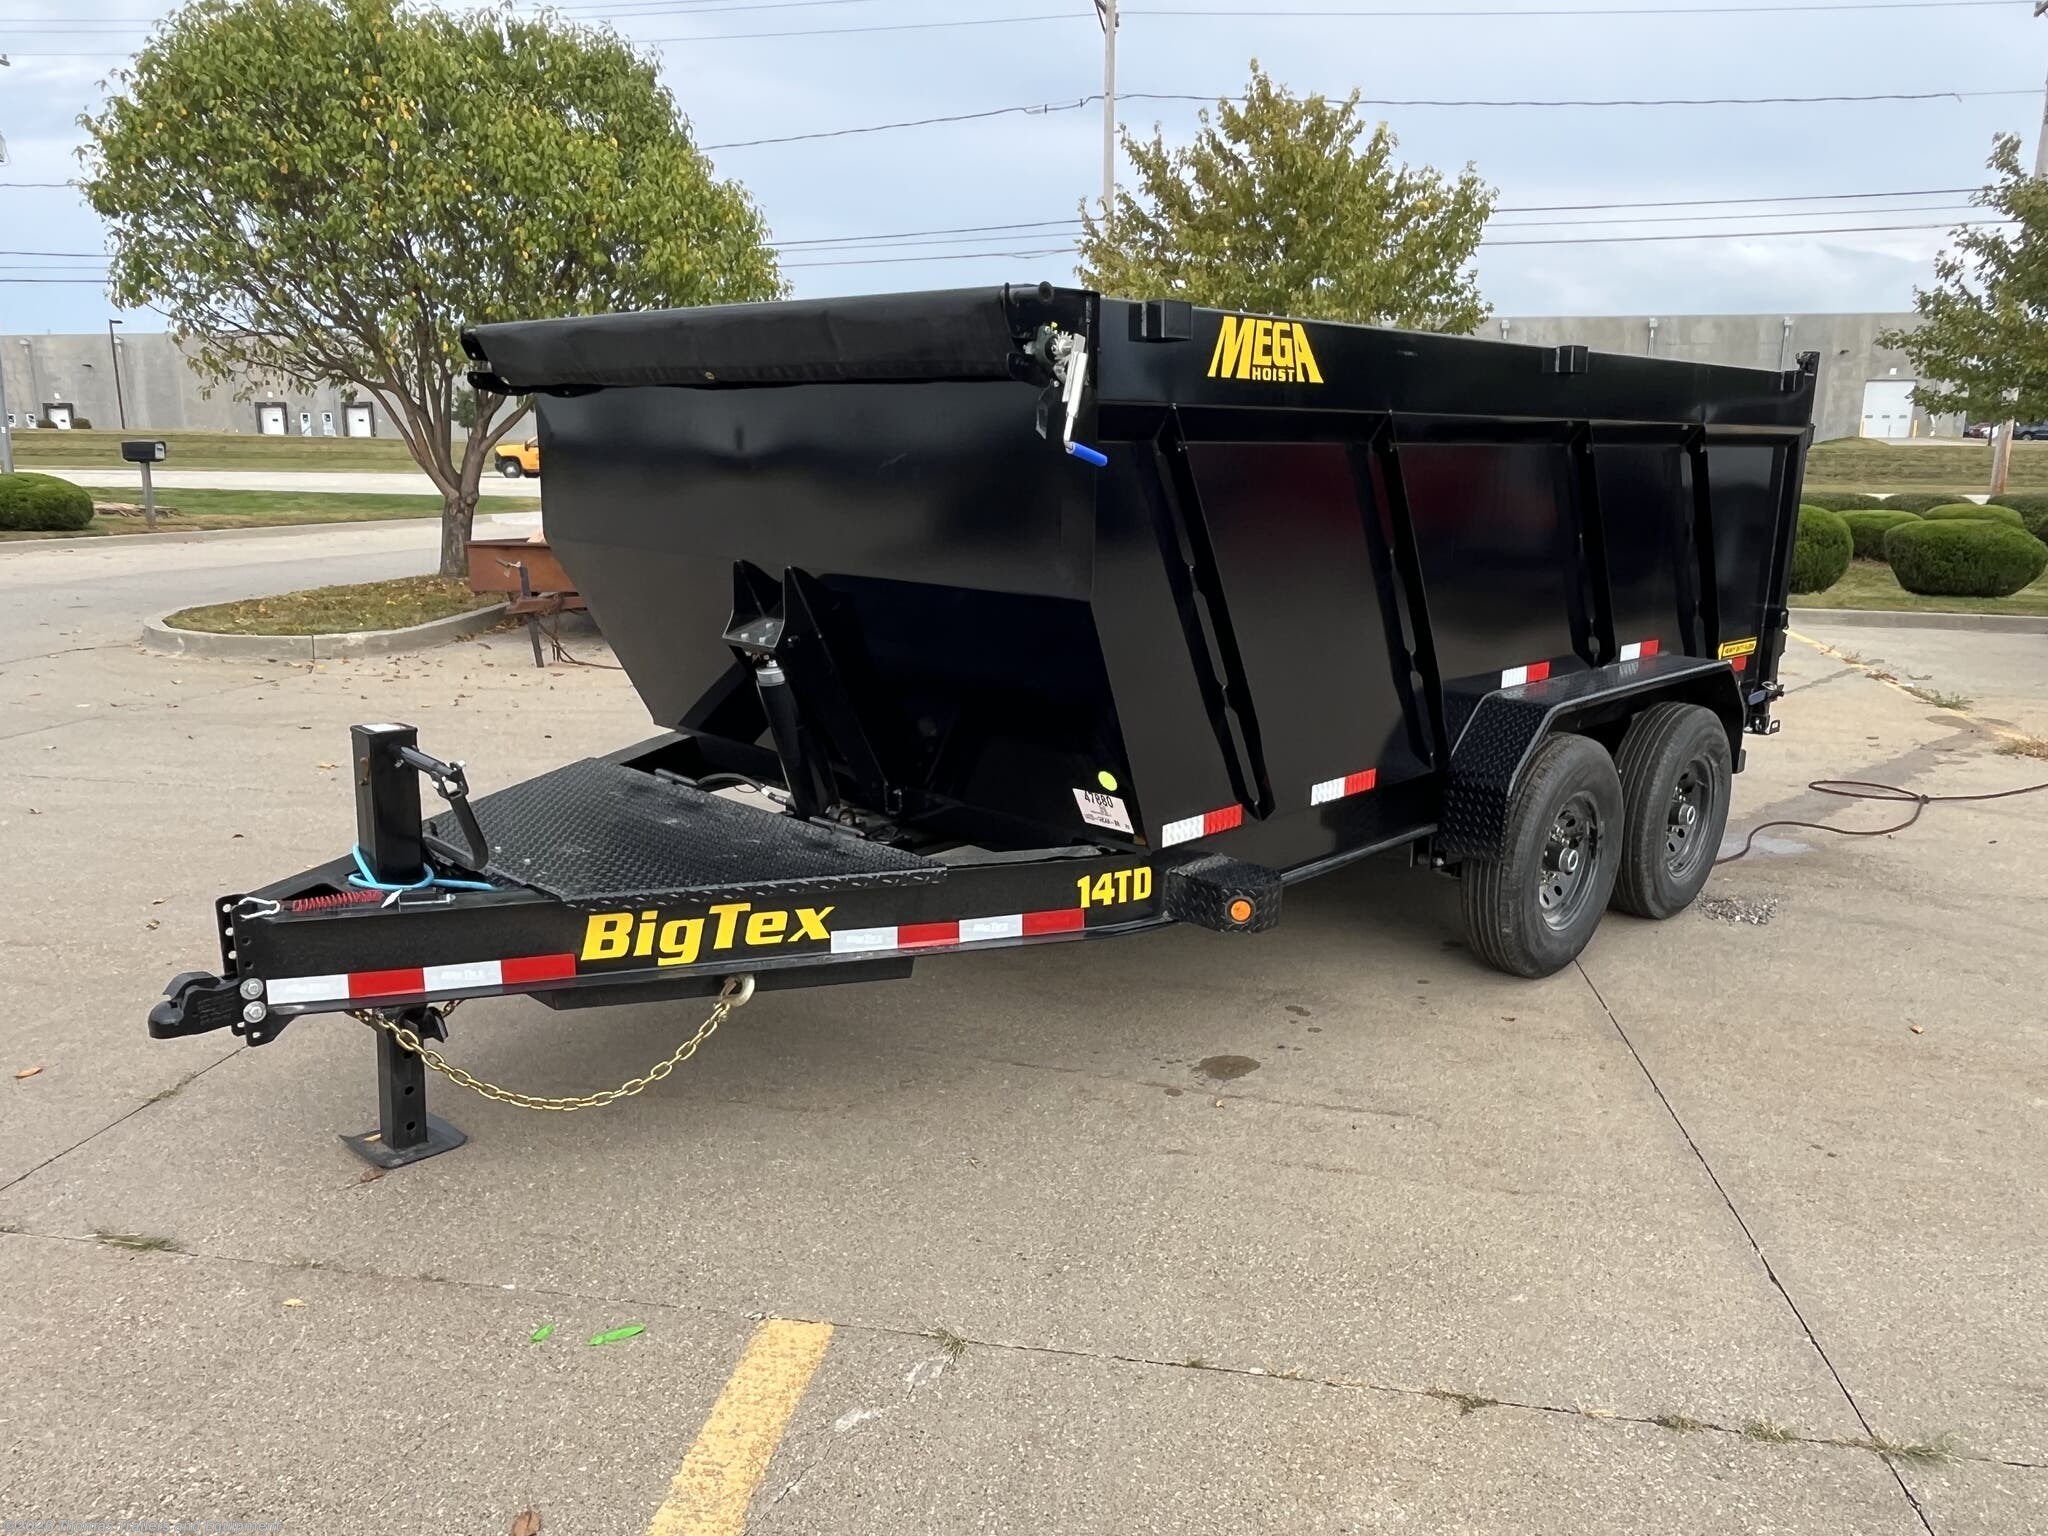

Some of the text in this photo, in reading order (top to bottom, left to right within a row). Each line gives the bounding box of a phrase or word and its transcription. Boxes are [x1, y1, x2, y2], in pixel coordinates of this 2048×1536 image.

[1207, 316, 1324, 383] MEGA
[1252, 366, 1295, 382] HOIST
[1077, 866, 1152, 908] 14TD
[580, 902, 835, 966] BigTex
